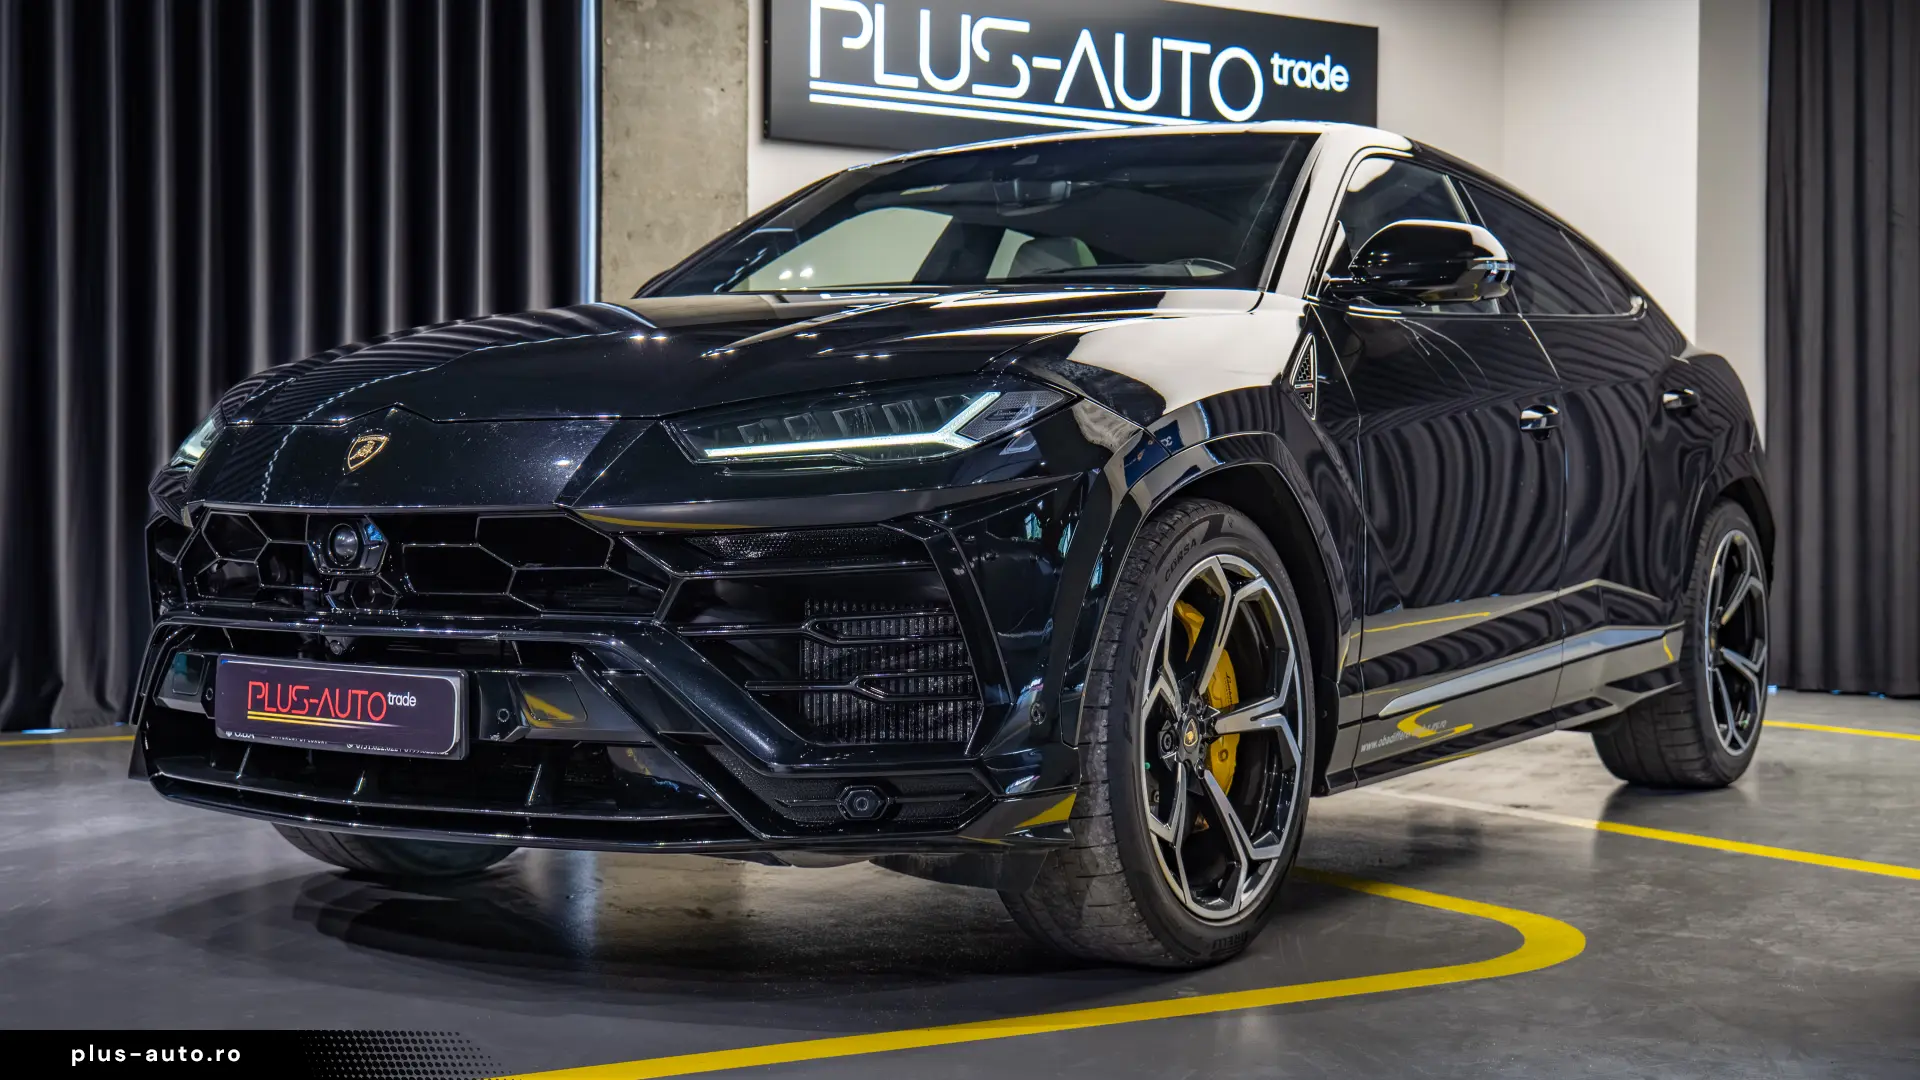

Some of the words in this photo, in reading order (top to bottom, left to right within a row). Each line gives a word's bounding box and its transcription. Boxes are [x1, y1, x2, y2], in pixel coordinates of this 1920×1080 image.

[809, 0, 1263, 121] PLUS-AUTO
[1270, 52, 1349, 92] trade
[1164, 538, 1198, 583] CORSA
[248, 681, 387, 721] PLUS-AUTO
[387, 692, 417, 707] trade
